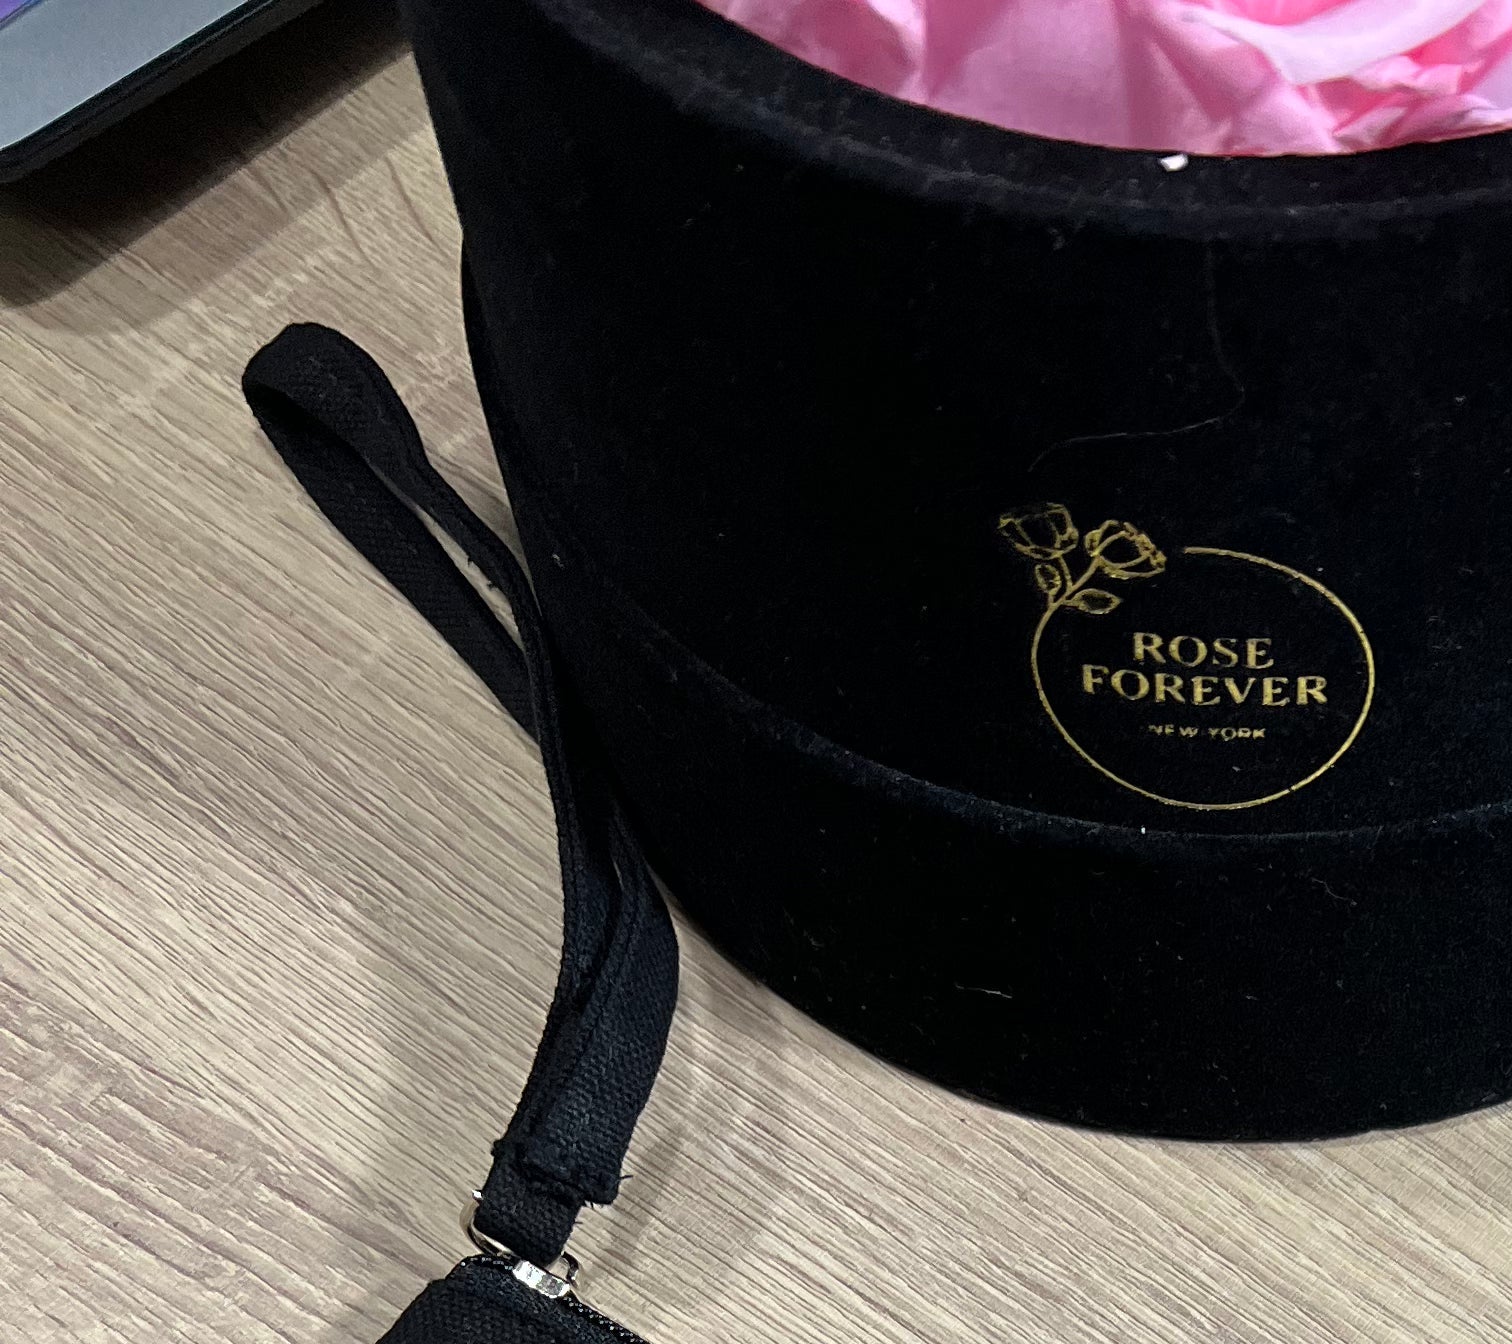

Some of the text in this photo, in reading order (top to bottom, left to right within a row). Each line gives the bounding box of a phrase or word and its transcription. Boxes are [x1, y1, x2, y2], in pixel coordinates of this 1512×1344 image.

[1132, 631, 1275, 670] ROSE
[1081, 663, 1328, 707] FOREVER
[1149, 723, 1267, 741] NEW YORK
